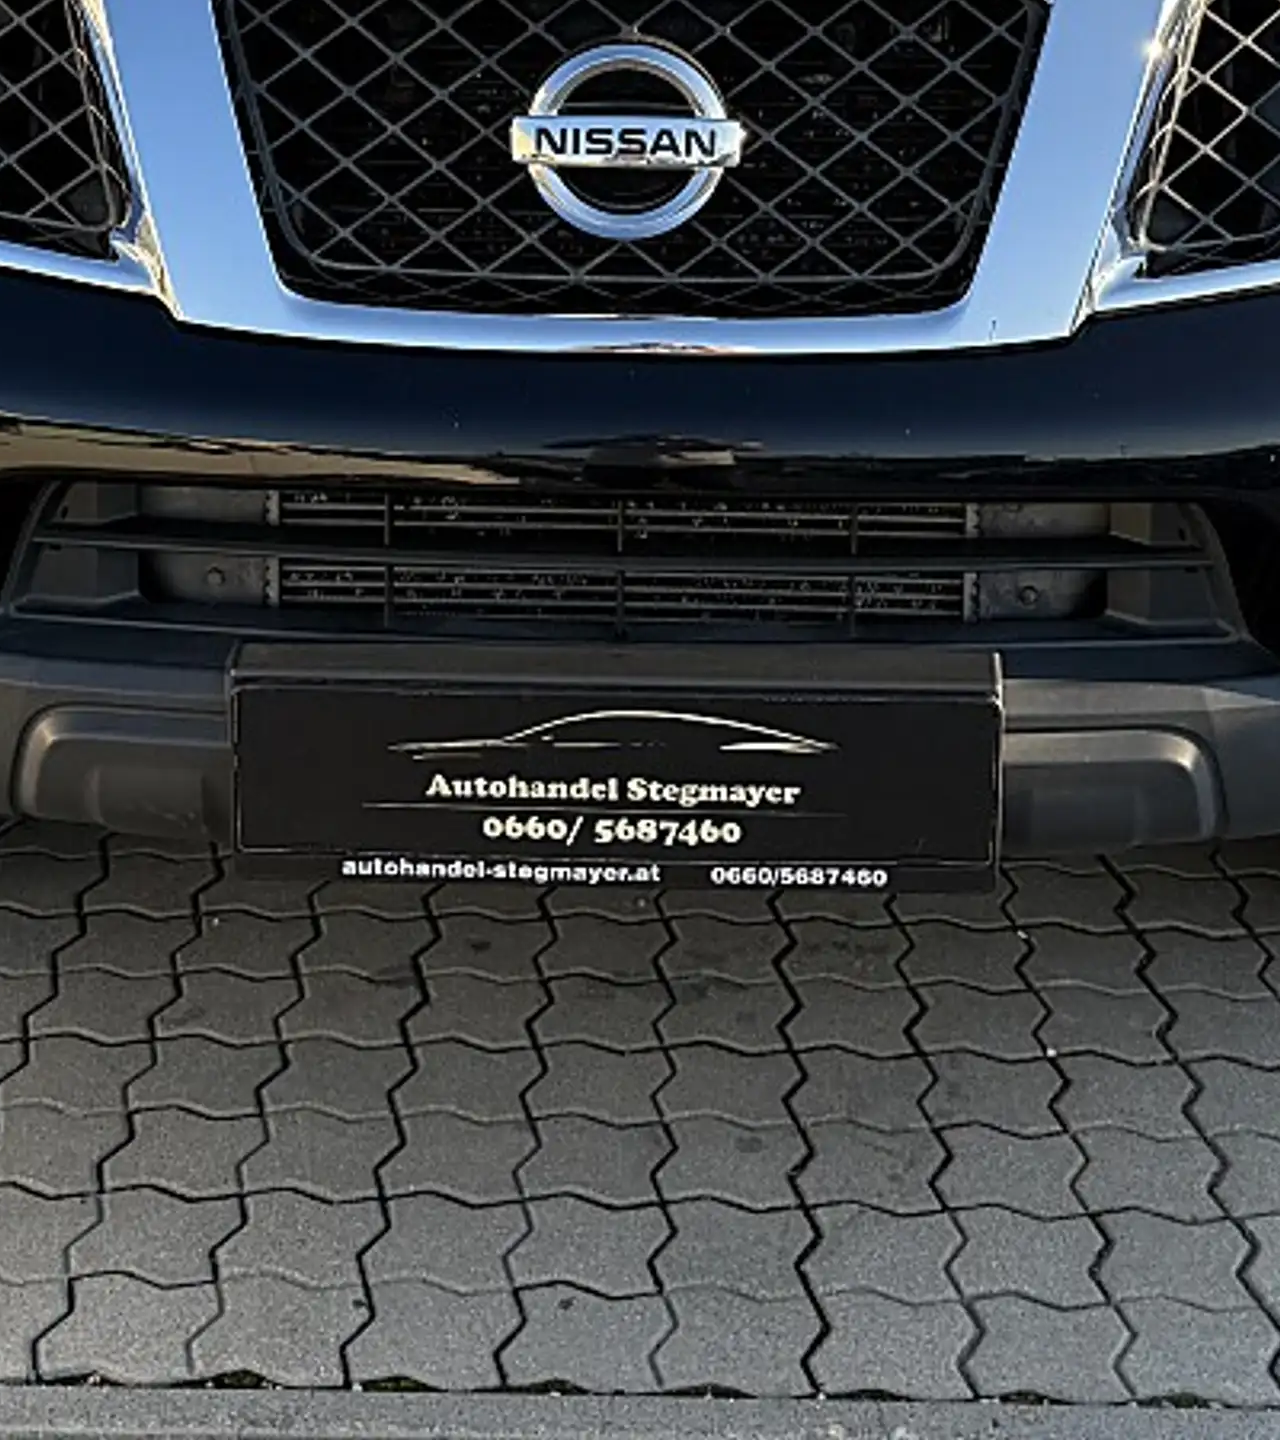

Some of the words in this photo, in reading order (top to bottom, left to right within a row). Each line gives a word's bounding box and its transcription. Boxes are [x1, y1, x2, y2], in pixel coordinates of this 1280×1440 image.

[535, 127, 716, 158] NISSAN
[425, 773, 619, 801] Autohandel
[626, 778, 801, 808] Stegmayer
[482, 815, 584, 846] 0660/
[593, 816, 742, 847] 5687460
[342, 858, 661, 885] autohandel-stegmayer.at
[710, 866, 888, 888] 0660/5687460
